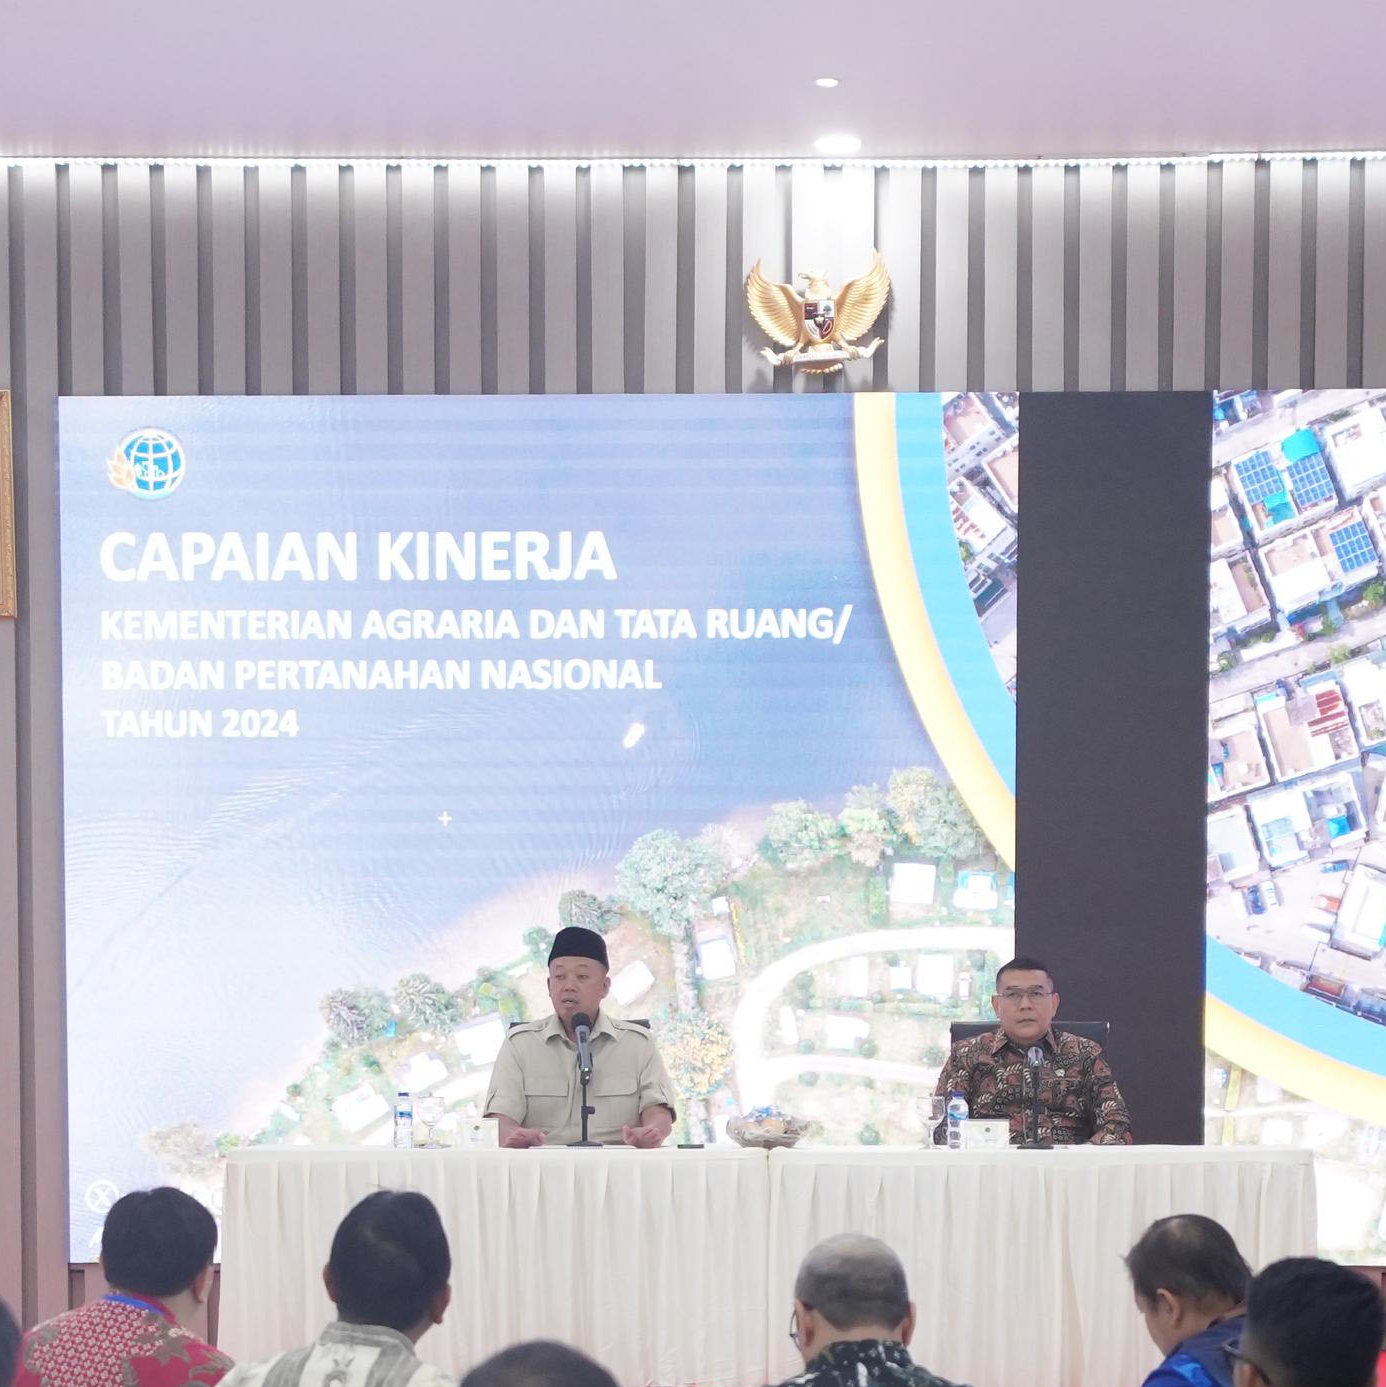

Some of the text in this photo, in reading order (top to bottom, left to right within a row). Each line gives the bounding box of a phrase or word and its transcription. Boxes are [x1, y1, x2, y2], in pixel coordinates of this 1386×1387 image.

[100, 530, 618, 582] CAPAIAN KINERJA
[100, 604, 853, 645] KEMENTERIAN AGRARIA DAN TATA RUANG/
[101, 658, 662, 690] BADAN PERTANAHAN NASIONAL
[101, 708, 300, 739] TAHUN 2024
